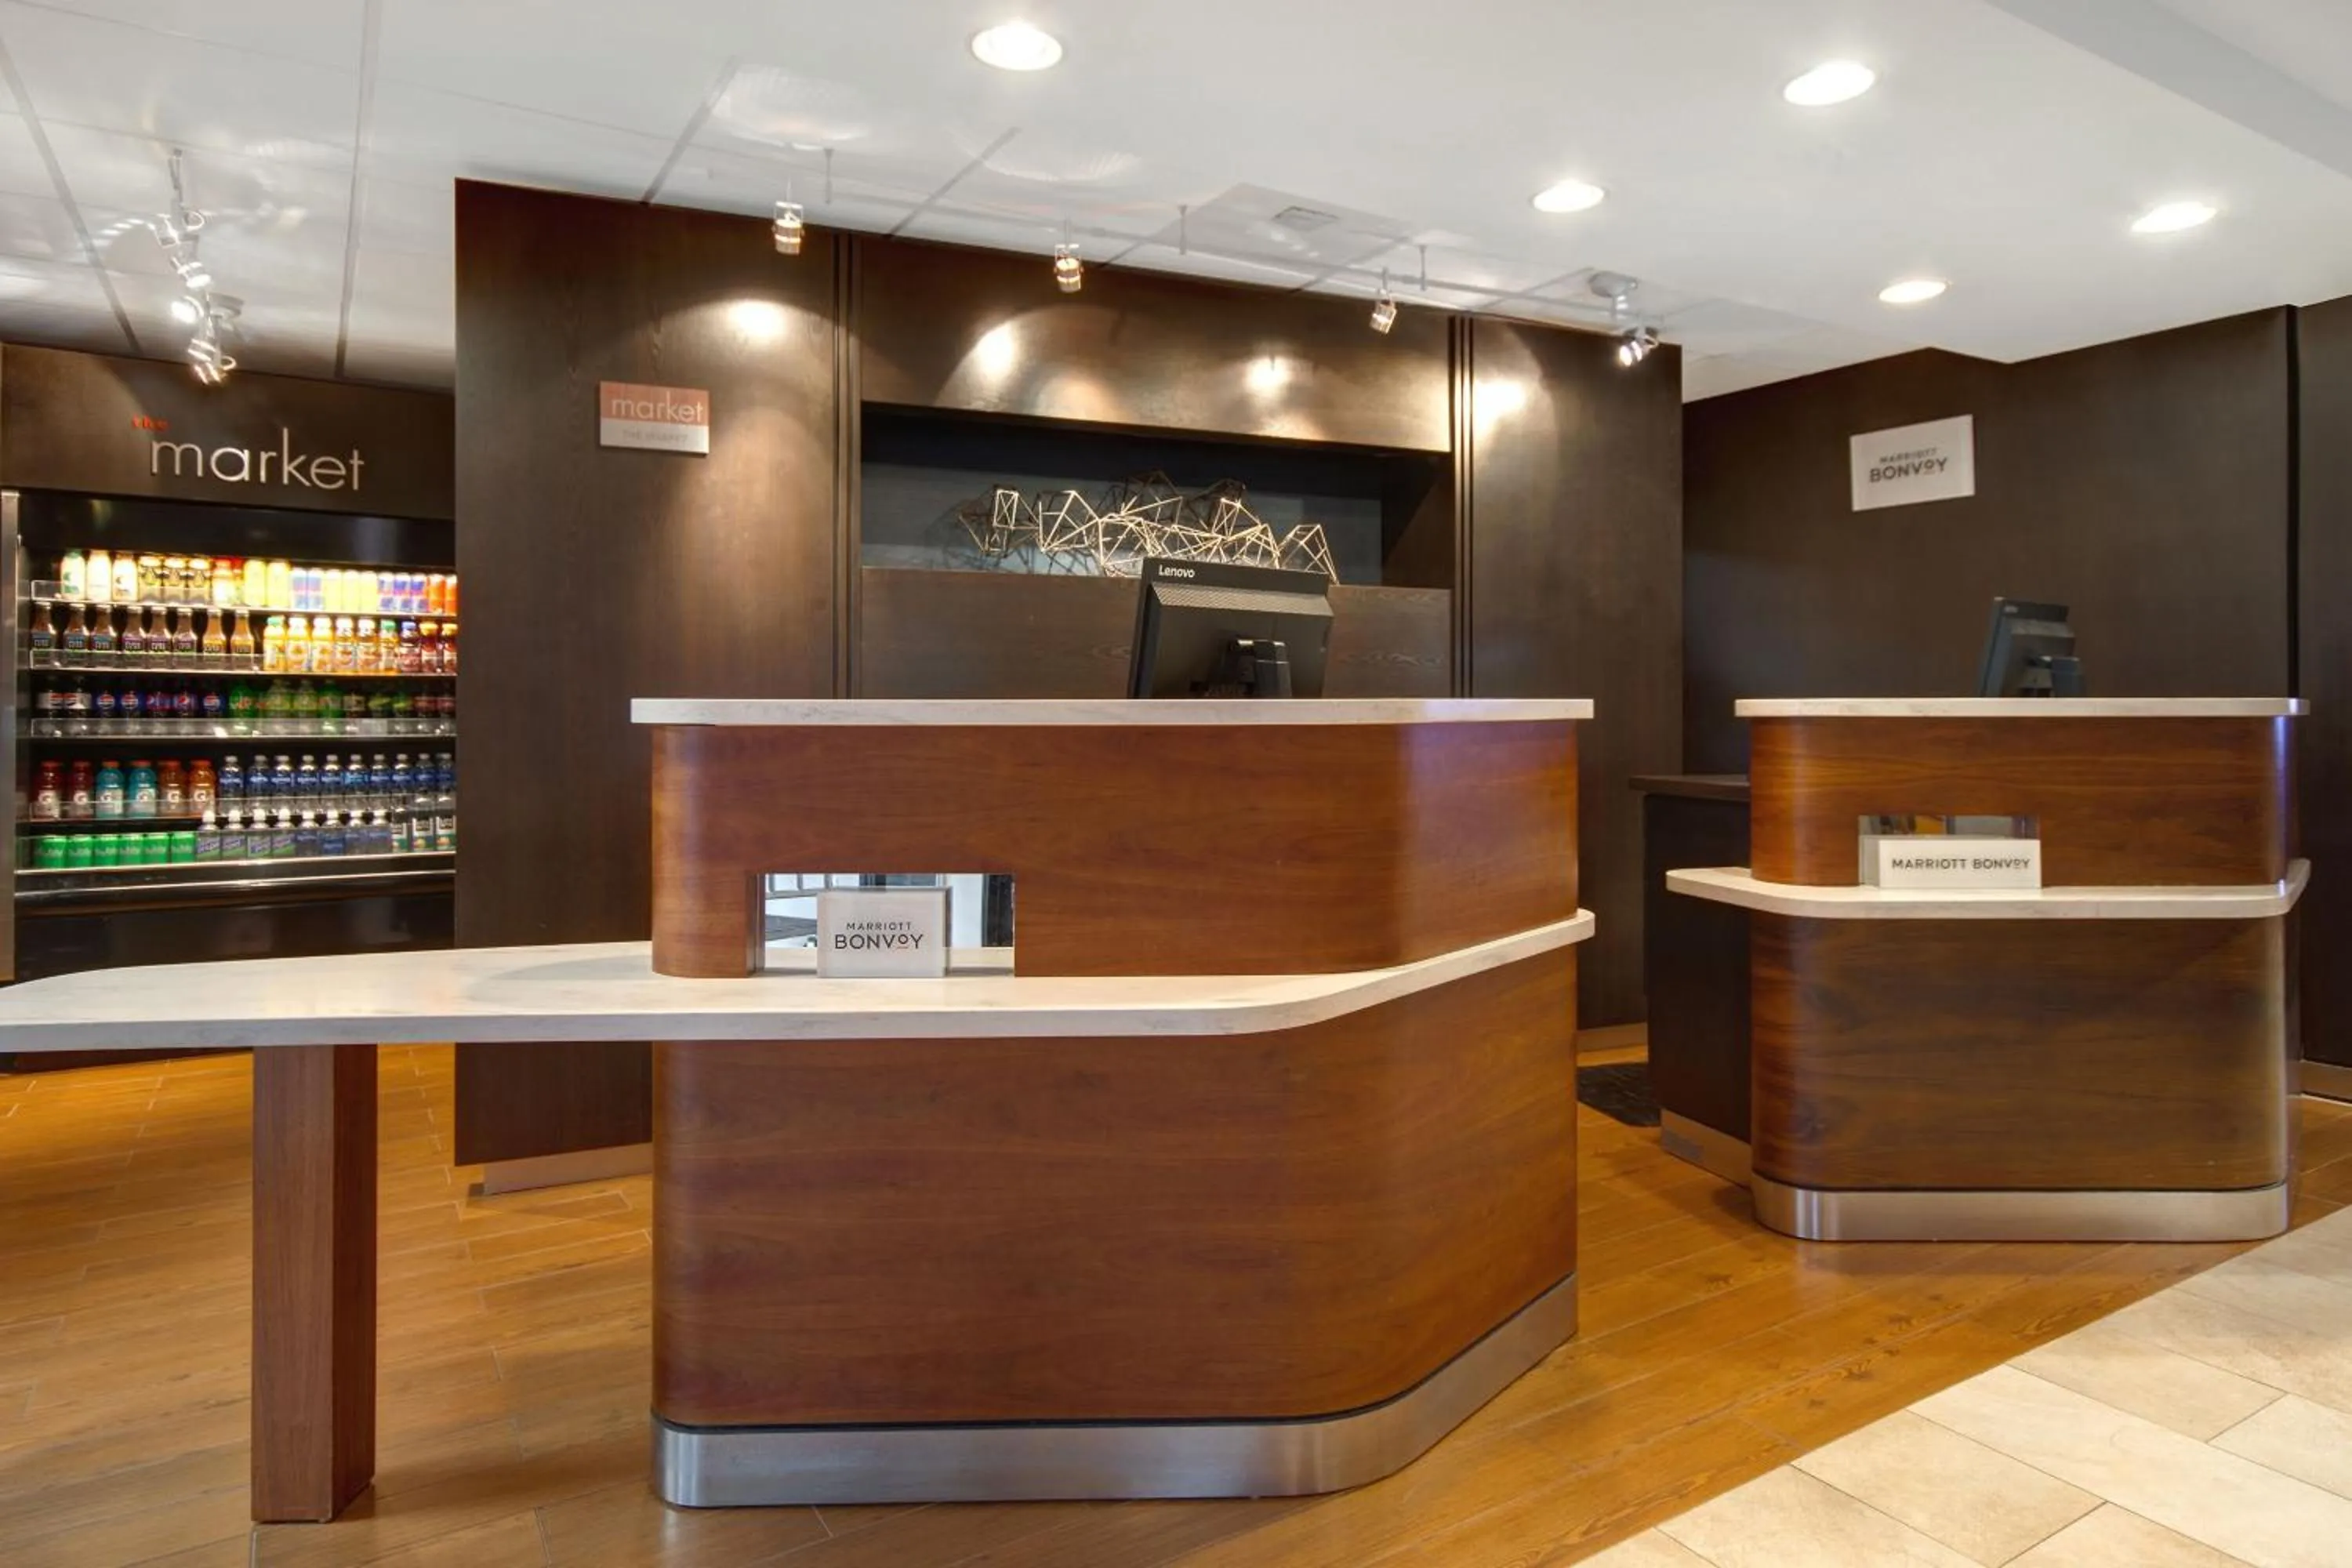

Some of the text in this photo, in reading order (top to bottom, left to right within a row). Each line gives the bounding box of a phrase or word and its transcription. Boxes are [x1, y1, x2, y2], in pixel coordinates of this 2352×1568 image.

[611, 390, 704, 423] market
[151, 426, 365, 491] market
[1879, 447, 1937, 463] MARRIOTT
[1869, 457, 1948, 483] BONVOY
[1158, 564, 1196, 578] Lenovo
[1892, 858, 2031, 869] MARRIOTT BONVOY
[846, 921, 912, 931] MARRIOTT
[835, 934, 924, 949] BONVOY
